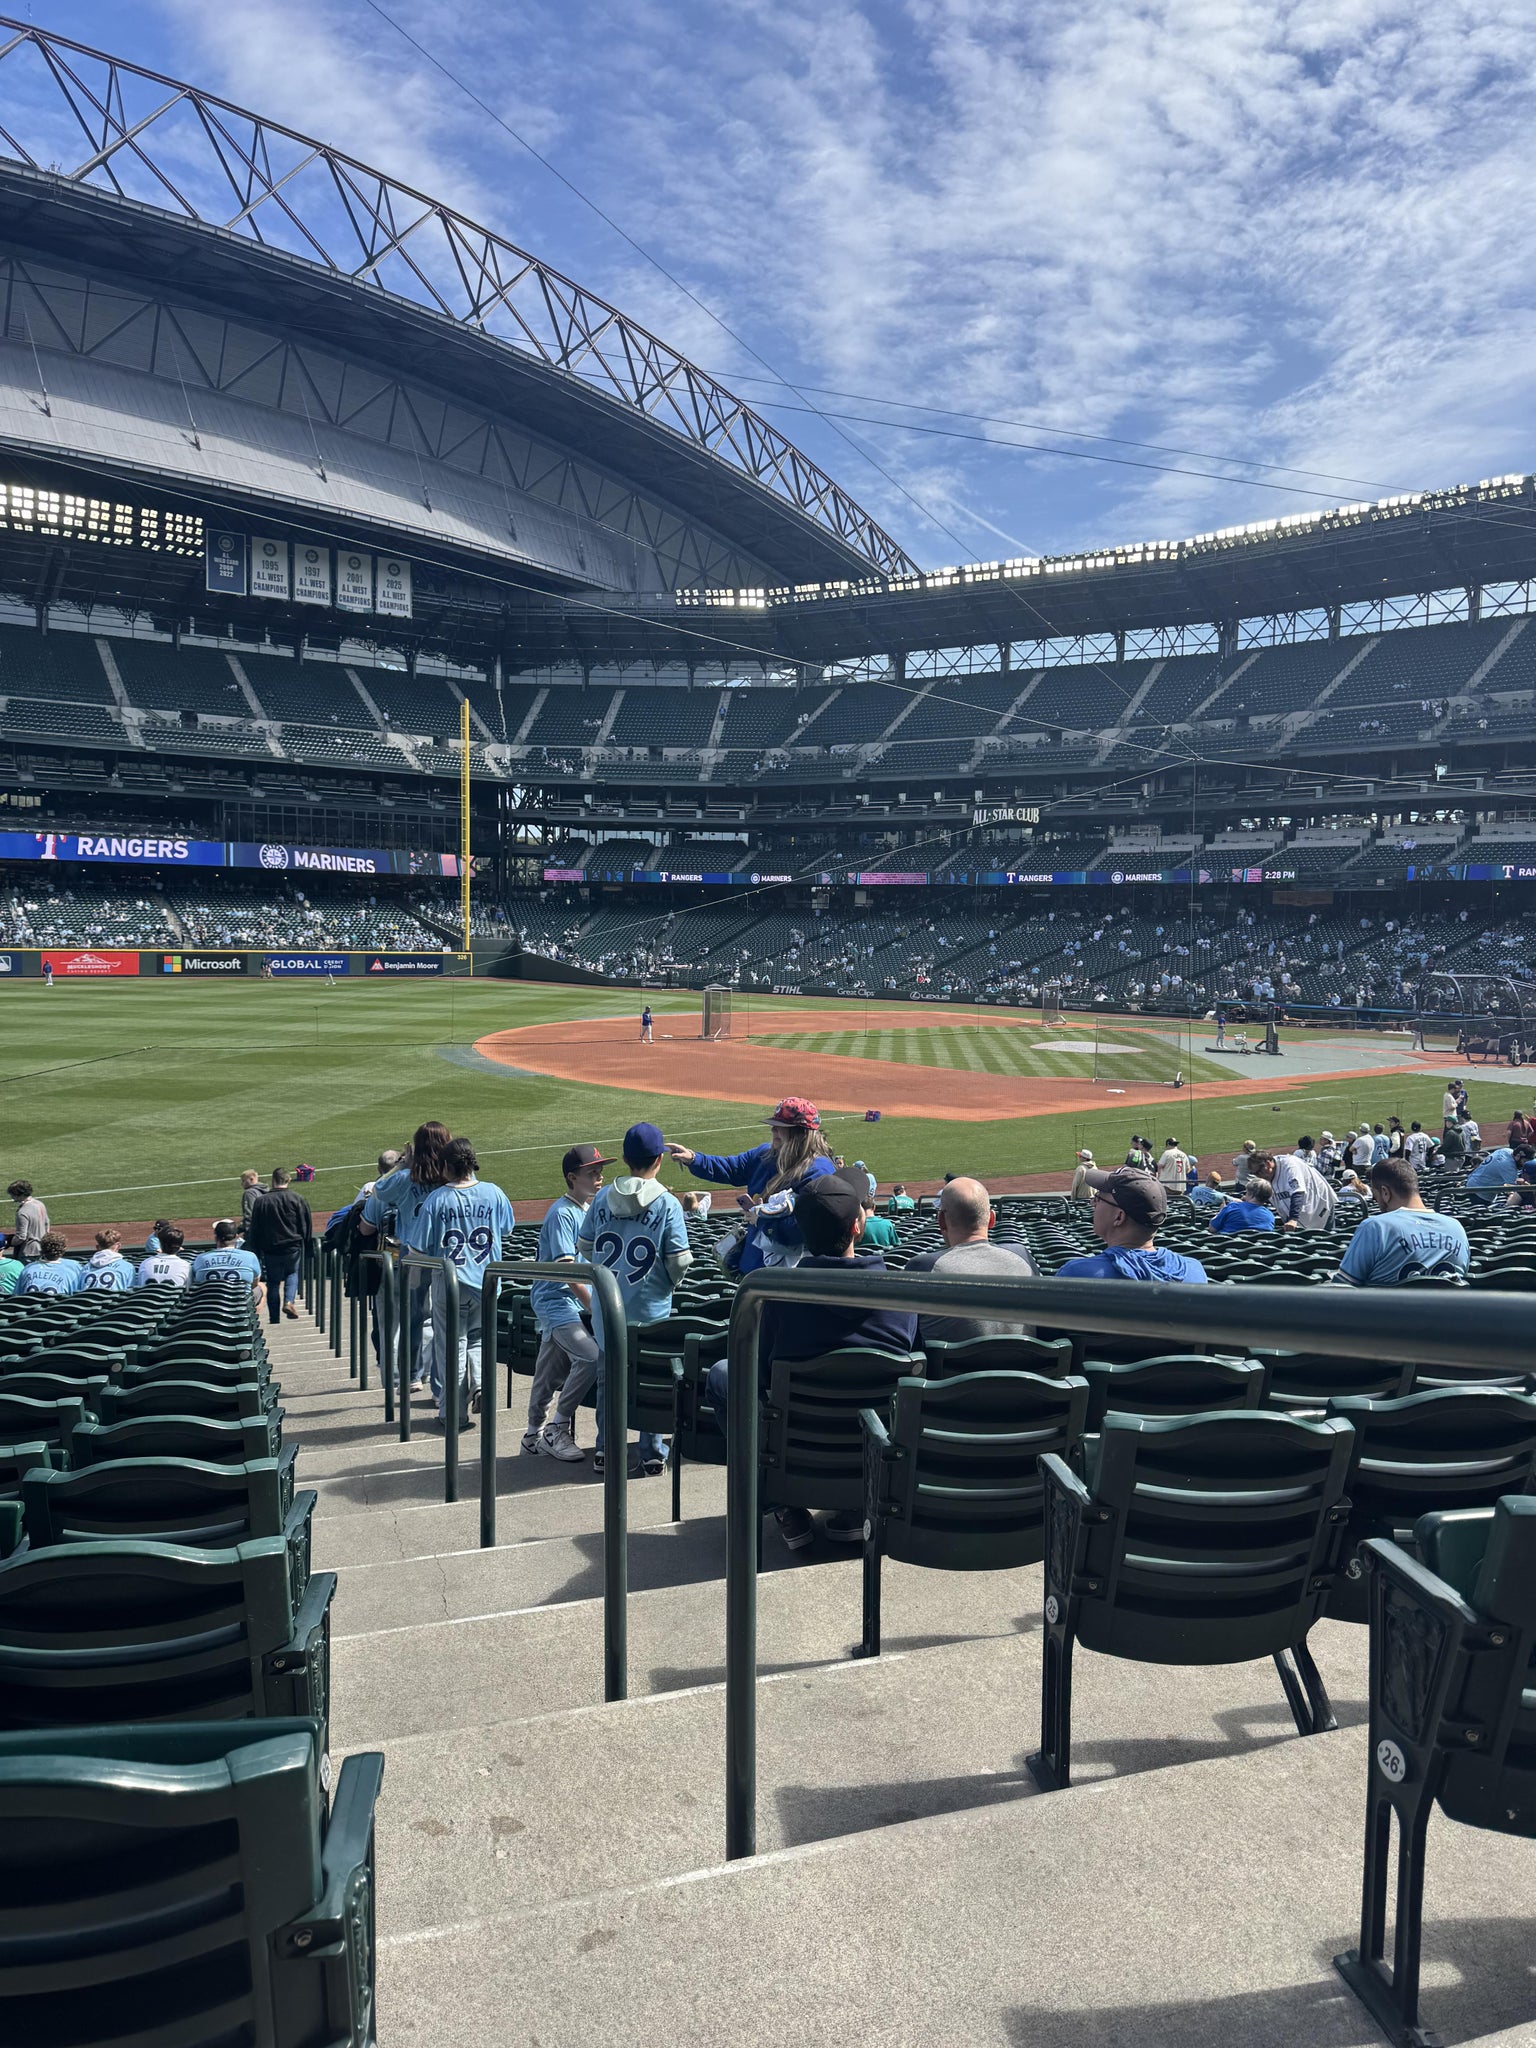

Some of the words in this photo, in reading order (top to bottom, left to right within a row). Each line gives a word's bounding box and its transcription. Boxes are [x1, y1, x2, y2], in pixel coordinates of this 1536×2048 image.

[262, 560, 279, 571] 1995
[257, 571, 266, 580] A.L.
[268, 573, 284, 583] WEST
[304, 566, 320, 578] 1997
[346, 572, 363, 584] 2001
[253, 582, 287, 594] CHAMPIONS
[299, 578, 309, 586] A.L.
[310, 579, 326, 589] WEST
[341, 584, 352, 593] A.L.
[352, 585, 368, 595] WEST
[386, 579, 402, 590] 2025
[296, 588, 329, 600] CHAMPIONS
[338, 594, 371, 606] CHAMPIONS
[382, 590, 392, 599] A.L.
[392, 592, 406, 601] WEST
[379, 600, 409, 612] CHAMPIONS
[1016, 807, 1040, 824] CLUB
[77, 837, 189, 859] RANGERS
[294, 850, 376, 873] MARINERS
[1018, 874, 1053, 882] RANGERS
[1125, 873, 1162, 881] MARINERS
[1265, 871, 1282, 879] 2:28
[1282, 871, 1295, 879] PM
[184, 958, 241, 970] Microsoft
[271, 959, 322, 969] GLOBAL
[384, 961, 416, 970] Benjamin
[772, 985, 803, 995] STIHL
[837, 987, 858, 996] Great
[857, 988, 875, 998] Clips
[440, 1204, 494, 1225] RALEIGH
[440, 1225, 494, 1267] 29
[1399, 1232, 1462, 1257] RALEIGH
[205, 1256, 243, 1269] RALEIGH
[594, 1231, 657, 1286] 29
[153, 1264, 170, 1274] WOO
[26, 1271, 64, 1285] RALEIGH
[84, 1271, 116, 1289] 29
[1048, 1600, 1057, 1618] 25
[1382, 1746, 1400, 1774] 26
